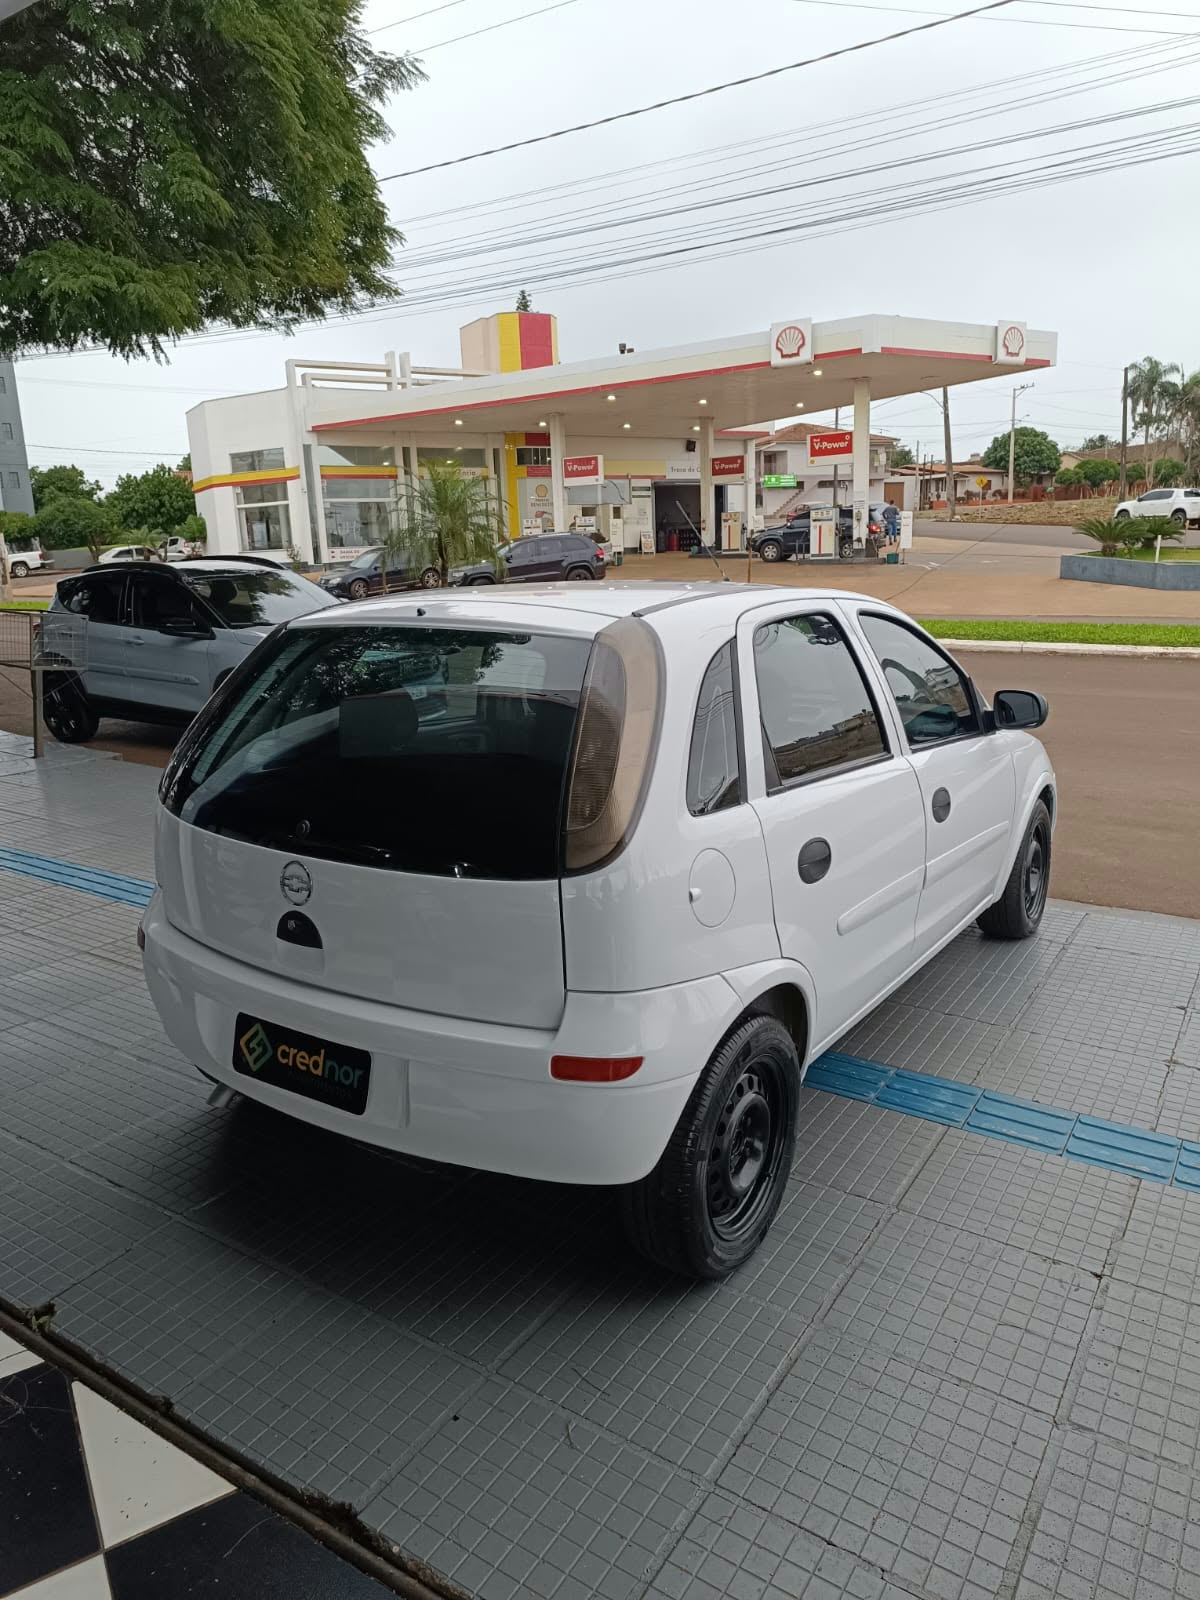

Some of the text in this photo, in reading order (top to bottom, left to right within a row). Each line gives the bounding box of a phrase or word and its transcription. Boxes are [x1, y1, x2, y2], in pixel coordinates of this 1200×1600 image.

[813, 440, 849, 450] V-Power
[567, 464, 594, 472] V-Power
[714, 462, 740, 471] V-Power
[276, 1043, 364, 1089] crednor
